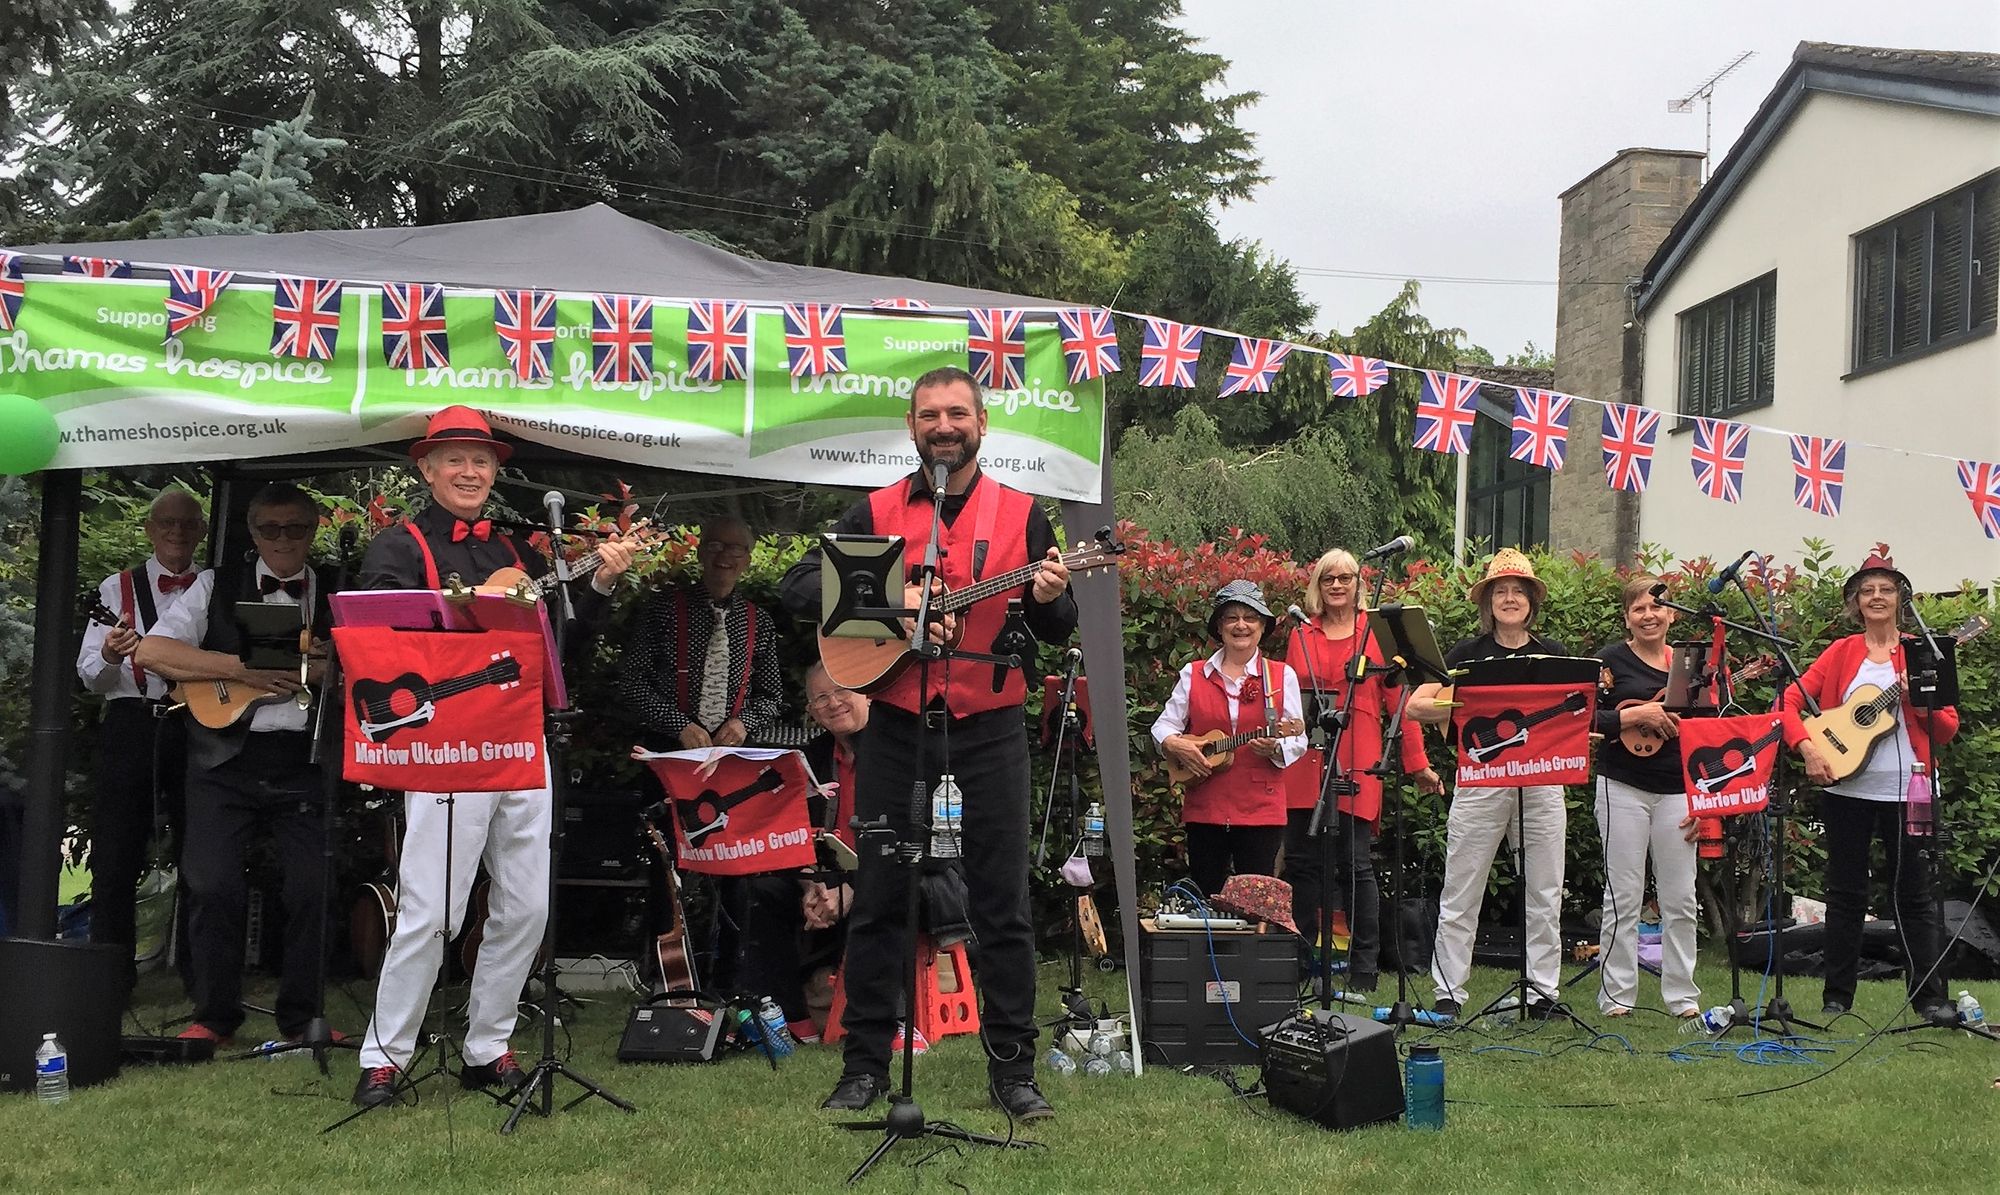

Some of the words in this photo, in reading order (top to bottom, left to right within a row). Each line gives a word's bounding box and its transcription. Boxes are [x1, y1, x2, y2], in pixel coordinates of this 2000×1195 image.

[96, 307, 217, 333] Suppong
[883, 336, 970, 353] Supporti
[155, 337, 332, 389] hospice
[59, 418, 287, 444] w.thameshospice.org.uk
[810, 448, 1046, 473] www.thamese.org.uk
[354, 741, 409, 765] Marlow
[411, 740, 478, 765] Ukulele
[481, 740, 536, 762] Group
[1460, 763, 1505, 782] Marlow
[1506, 757, 1552, 776] Ukulele
[1552, 755, 1586, 771] Group
[1691, 791, 1740, 811] Marlow
[680, 842, 714, 861] Marlow
[714, 838, 765, 861] Ukulele
[768, 828, 808, 850] Group
